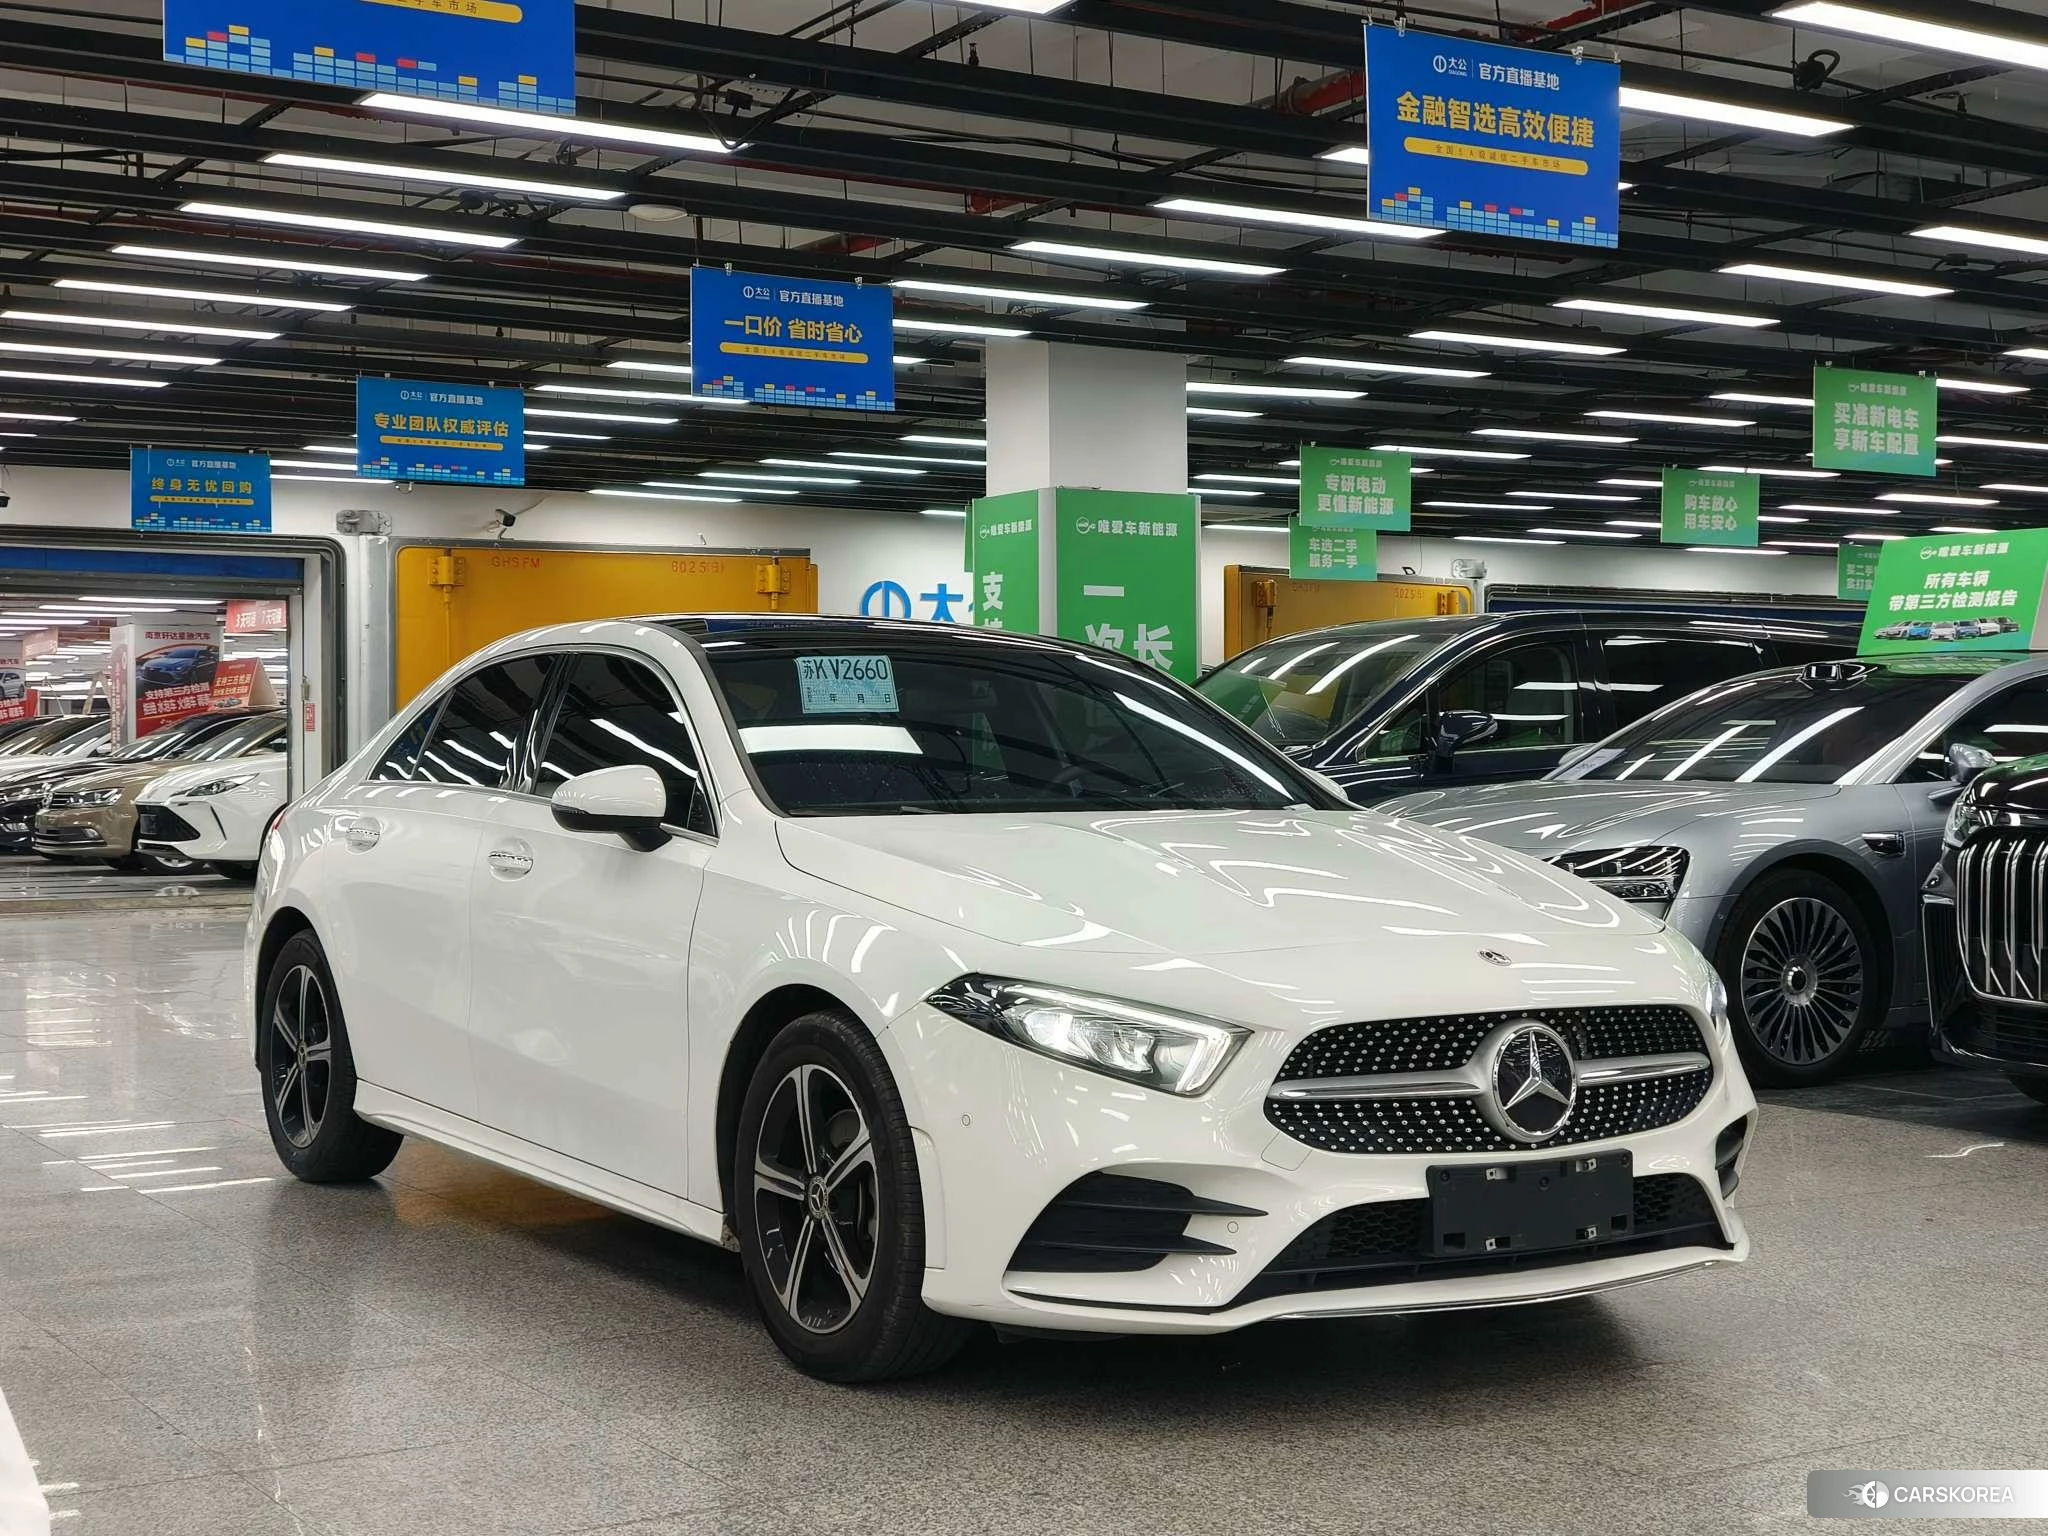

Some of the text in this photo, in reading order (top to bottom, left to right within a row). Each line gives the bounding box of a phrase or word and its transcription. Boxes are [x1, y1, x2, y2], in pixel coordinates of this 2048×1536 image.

[398, 0, 478, 14] 手车市场
[1448, 57, 1560, 91] 大公 官方直播基地
[1396, 91, 1595, 148] 金融智选高效便捷
[779, 290, 844, 307] 官方直播基地
[724, 316, 863, 344] 一口价 省时省心
[374, 412, 509, 438] 专业团队权威评估
[151, 478, 252, 494] 终身无忧回购
[1325, 473, 1386, 494] 专研电动
[1317, 493, 1394, 515] 更懂新能源
[1098, 519, 1178, 537] 唯爱车新能源
[1684, 513, 1738, 531] 用车安心
[1308, 537, 1357, 553] 车选二手
[1938, 542, 2009, 558] 唯爱车新能源
[1924, 570, 1991, 590] 所有车辆
[920, 584, 974, 623] 大
[1889, 590, 2018, 612] 带第三方检测报告
[803, 659, 888, 680] 苏KV2660
